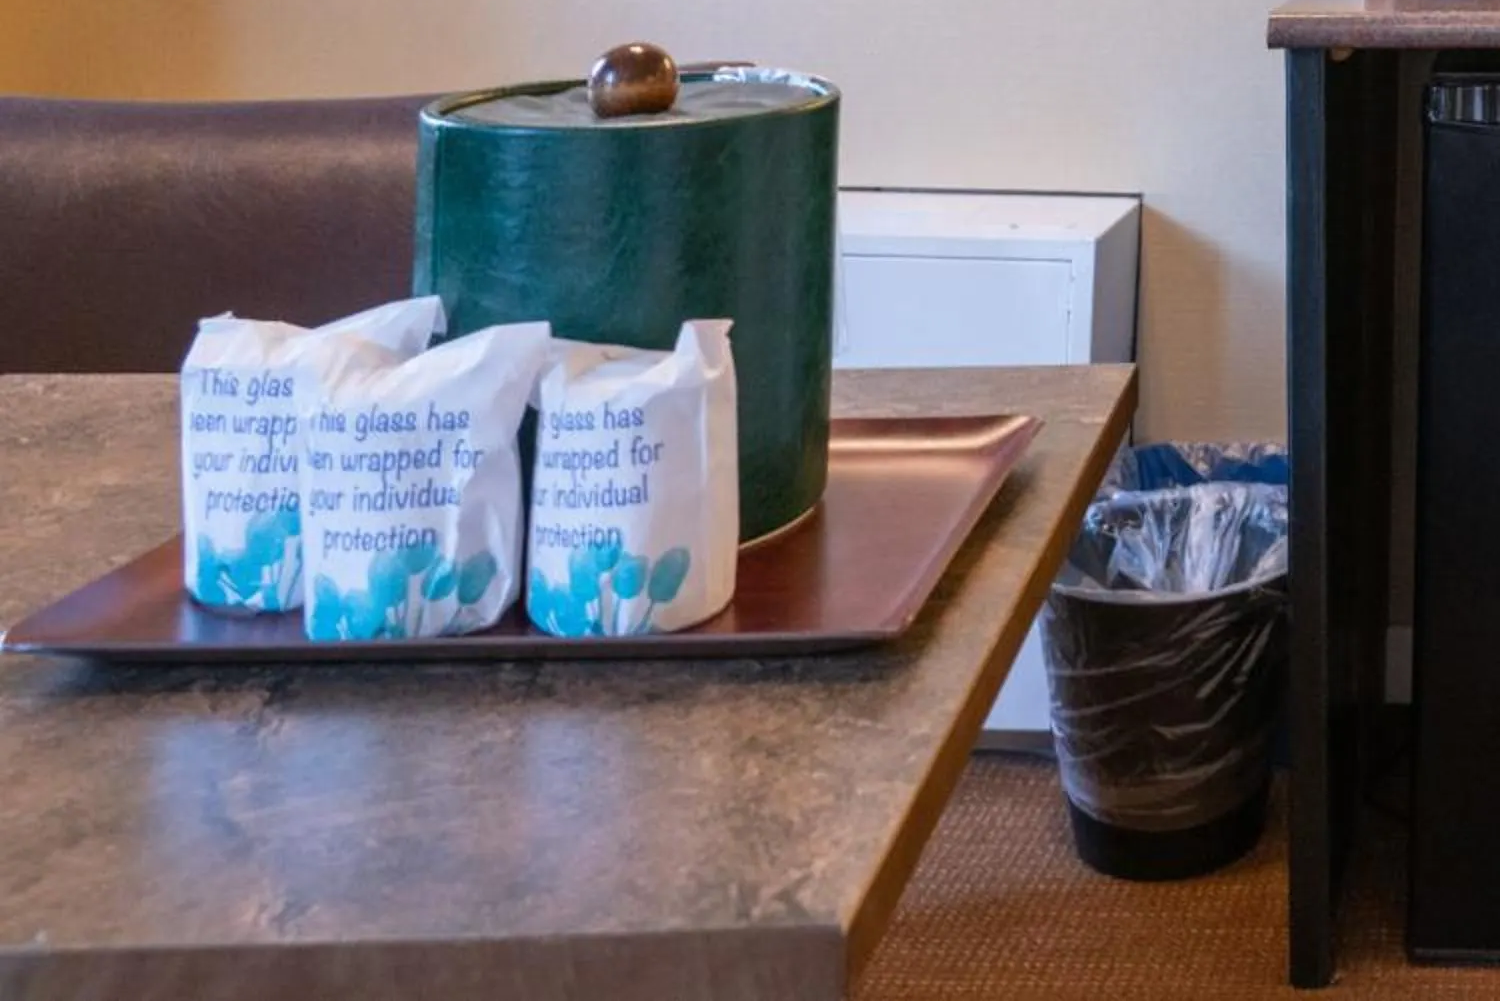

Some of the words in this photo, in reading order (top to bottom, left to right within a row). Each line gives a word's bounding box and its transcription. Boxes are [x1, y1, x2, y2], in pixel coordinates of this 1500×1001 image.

[198, 368, 239, 397] This
[245, 369, 295, 405] glas
[232, 413, 298, 447] wrapp
[354, 402, 417, 442] glass
[427, 401, 470, 431] has
[549, 401, 596, 440] glass
[603, 401, 645, 429] has
[193, 451, 234, 479] your
[239, 445, 298, 474] indivi
[340, 439, 443, 481] wrapped
[452, 437, 484, 469] for
[542, 439, 620, 480] wrapped
[630, 434, 665, 467] for
[205, 486, 301, 520] protectio
[352, 478, 460, 511] individua
[552, 473, 649, 509] individual
[323, 522, 437, 559] protection
[535, 521, 622, 554] protection
